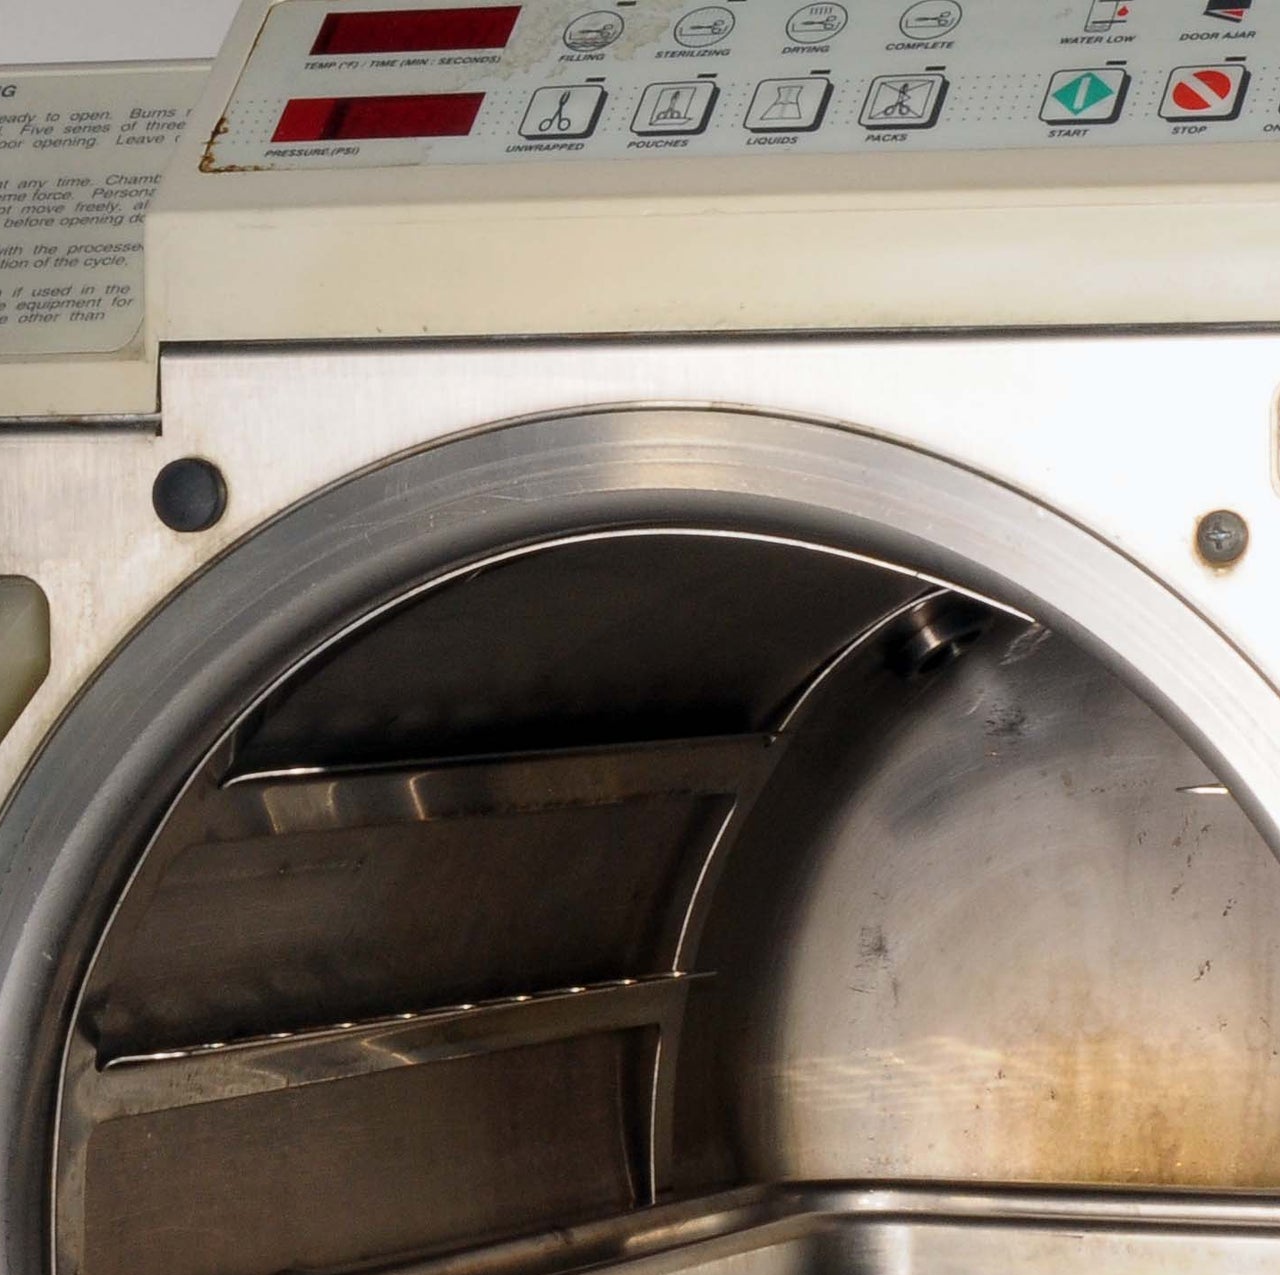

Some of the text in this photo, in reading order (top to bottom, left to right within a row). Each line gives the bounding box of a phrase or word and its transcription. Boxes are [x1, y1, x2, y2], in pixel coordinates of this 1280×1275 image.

[1059, 35, 1137, 46] WATER LOW
[1179, 30, 1256, 42] DOOR AJAR
[782, 45, 830, 55] DRYING
[885, 41, 954, 51] COMPLETE
[559, 52, 606, 63] FILLING
[655, 48, 731, 59] STERILIZING
[304, 60, 398, 70] TEMP TIME
[46, 112, 60, 123] to
[20, 124, 54, 136] Five
[63, 122, 111, 134] series
[121, 121, 138, 132] of
[146, 120, 187, 132] three
[1048, 128, 1090, 139] START
[1172, 126, 1207, 135] STOP
[115, 134, 165, 146] Leave
[746, 136, 798, 146] LIQUIDS
[865, 134, 908, 143] PACKS
[505, 142, 584, 153] UNWRAPPED
[627, 140, 688, 150] POUCHES
[264, 146, 360, 157] PRESSURE (PSI)
[17, 178, 47, 192] any
[21, 204, 65, 215] move
[3, 215, 55, 229] before
[59, 214, 124, 228] opening
[33, 244, 59, 256] the
[33, 256, 50, 269] of
[54, 255, 79, 267] the
[12, 286, 24, 298] if
[32, 284, 73, 298] used
[81, 284, 96, 296] in
[105, 283, 131, 295] the
[16, 297, 102, 312] equipment
[112, 296, 134, 308] for
[17, 310, 61, 324] other
[69, 310, 106, 322] than
